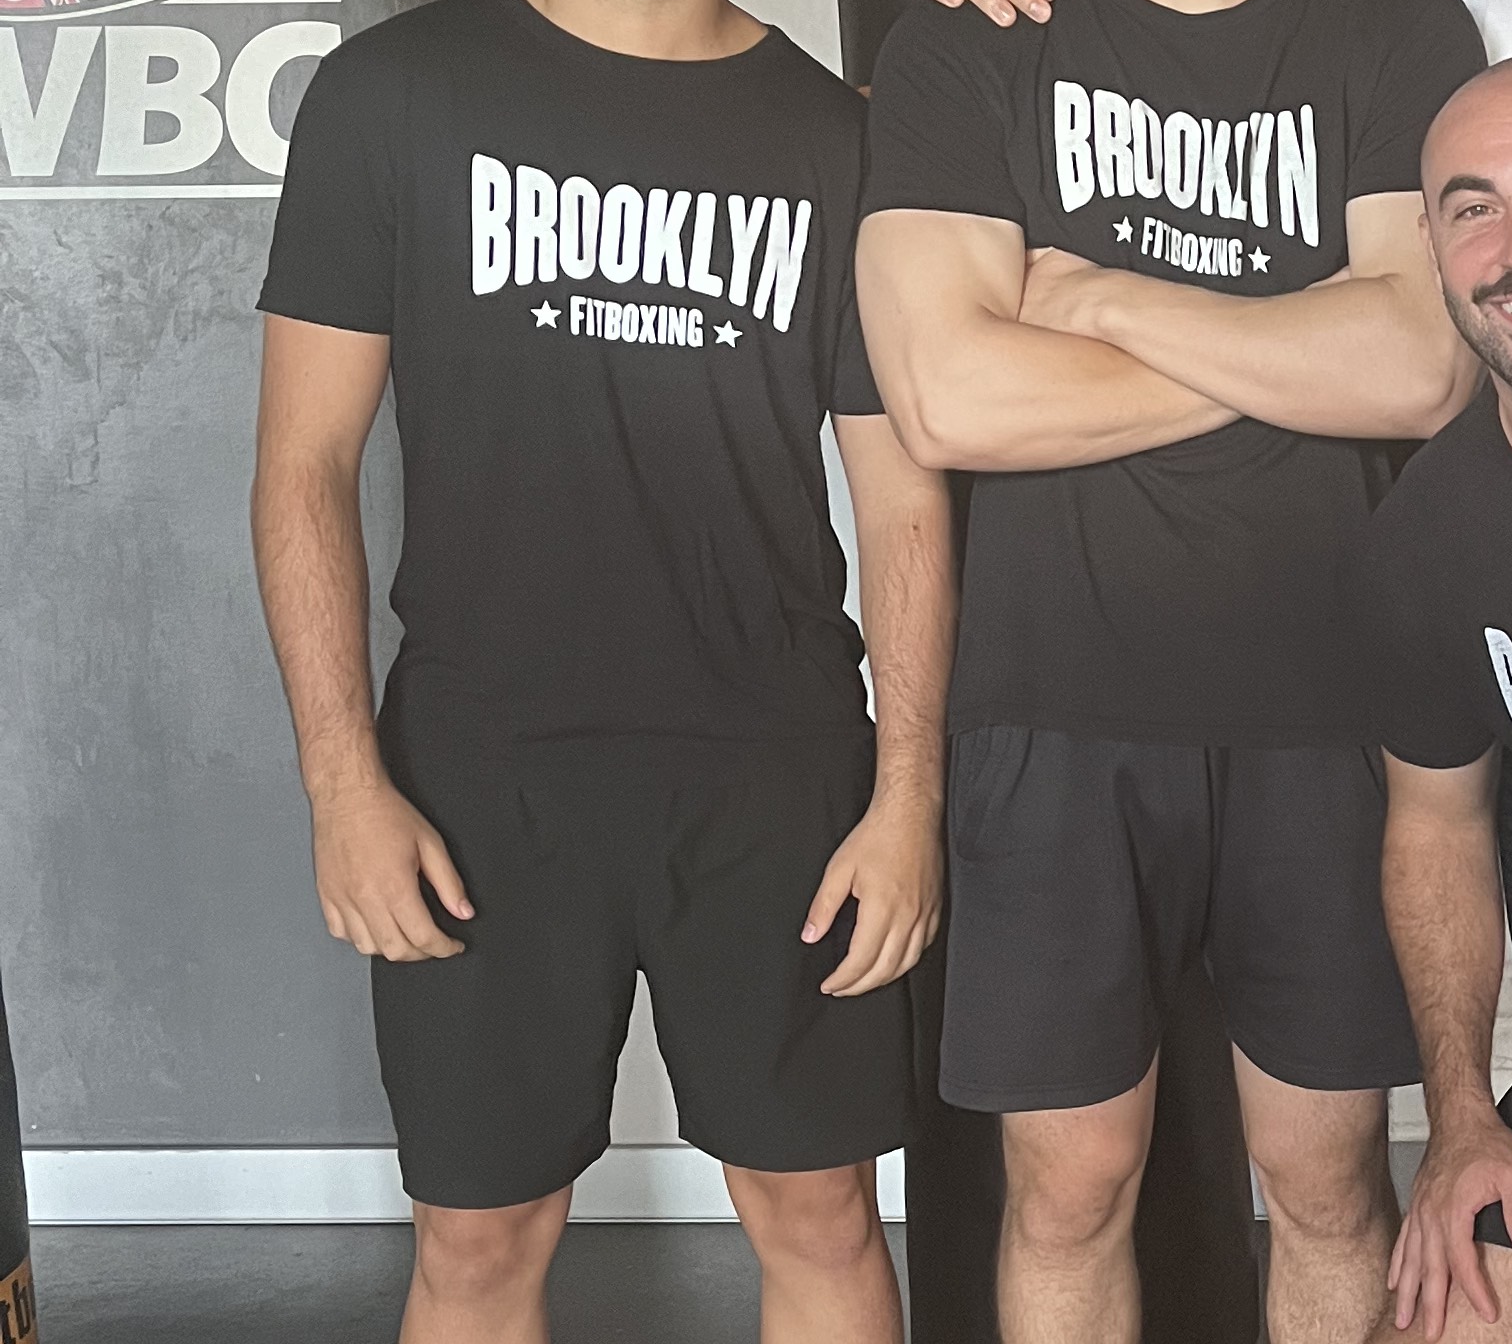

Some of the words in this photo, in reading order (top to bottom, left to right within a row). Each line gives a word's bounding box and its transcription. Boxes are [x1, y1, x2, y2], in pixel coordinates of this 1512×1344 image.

[1054, 80, 1319, 247] BROOKLYN
[471, 153, 812, 333] BROOKLYN
[1141, 216, 1243, 277] FITBOXING
[569, 295, 704, 348] FITBOXING
